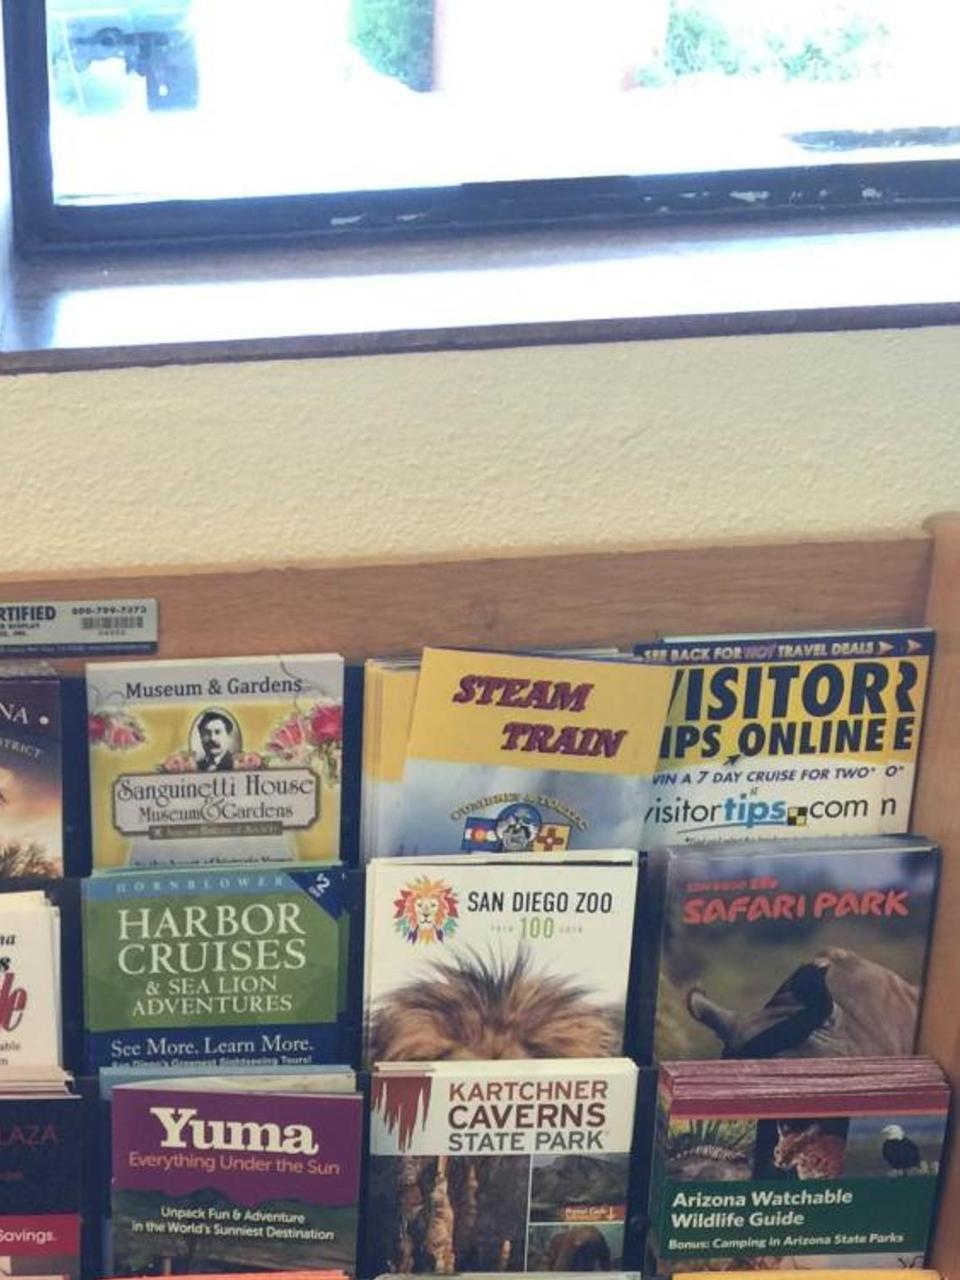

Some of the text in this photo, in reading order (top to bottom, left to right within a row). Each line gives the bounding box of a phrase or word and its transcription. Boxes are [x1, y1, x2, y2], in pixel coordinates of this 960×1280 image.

[672, 641, 874, 661] BACK TRAVEL DEALS
[125, 678, 303, 700] Museum Gardens
[452, 674, 595, 713] STEAM
[500, 720, 630, 759] TRAIN
[738, 717, 885, 757] ONLINE
[245, 775, 314, 797] House
[747, 769, 796, 782] CRUISE
[467, 891, 613, 914] SAN DIEGO ZOO
[682, 889, 910, 925] SAFARI PARK
[117, 902, 307, 940] HARBOR
[117, 938, 308, 976] CRUISES
[167, 975, 278, 996] SEA LION
[131, 995, 293, 1017] ADVENTURES
[110, 1036, 255, 1058] See More. Learn
[448, 1080, 608, 1103] KARTCHNER
[447, 1102, 606, 1130] CAVERNS
[149, 1106, 319, 1156] Yuma
[447, 1129, 604, 1153] STATE PARK
[128, 1151, 340, 1176] Everything Under the Sun
[672, 1188, 854, 1208] Arizona Watchable
[160, 1205, 305, 1225] Unpack Adventure
[671, 1210, 805, 1230] Wildlife Guide
[265, 1225, 334, 1241] Destination
[713, 1231, 904, 1251] Camping Arizona State Parks
